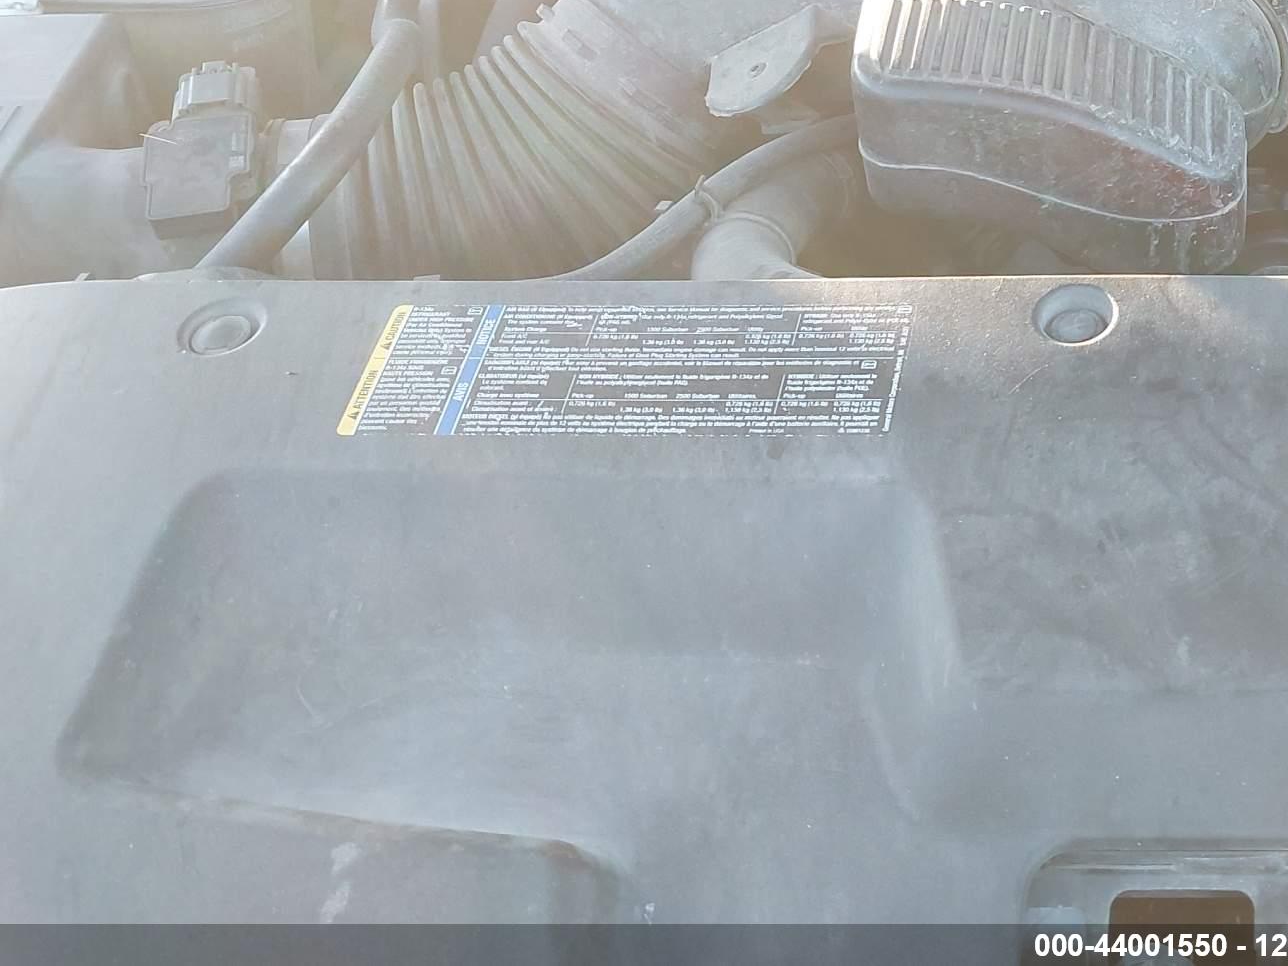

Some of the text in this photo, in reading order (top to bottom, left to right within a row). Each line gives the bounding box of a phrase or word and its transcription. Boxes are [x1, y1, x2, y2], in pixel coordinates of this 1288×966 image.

[385, 312, 406, 341] CAUTION
[476, 319, 496, 344] NOTICE
[356, 370, 379, 409] ATTENTION
[452, 382, 469, 402] AVIS
